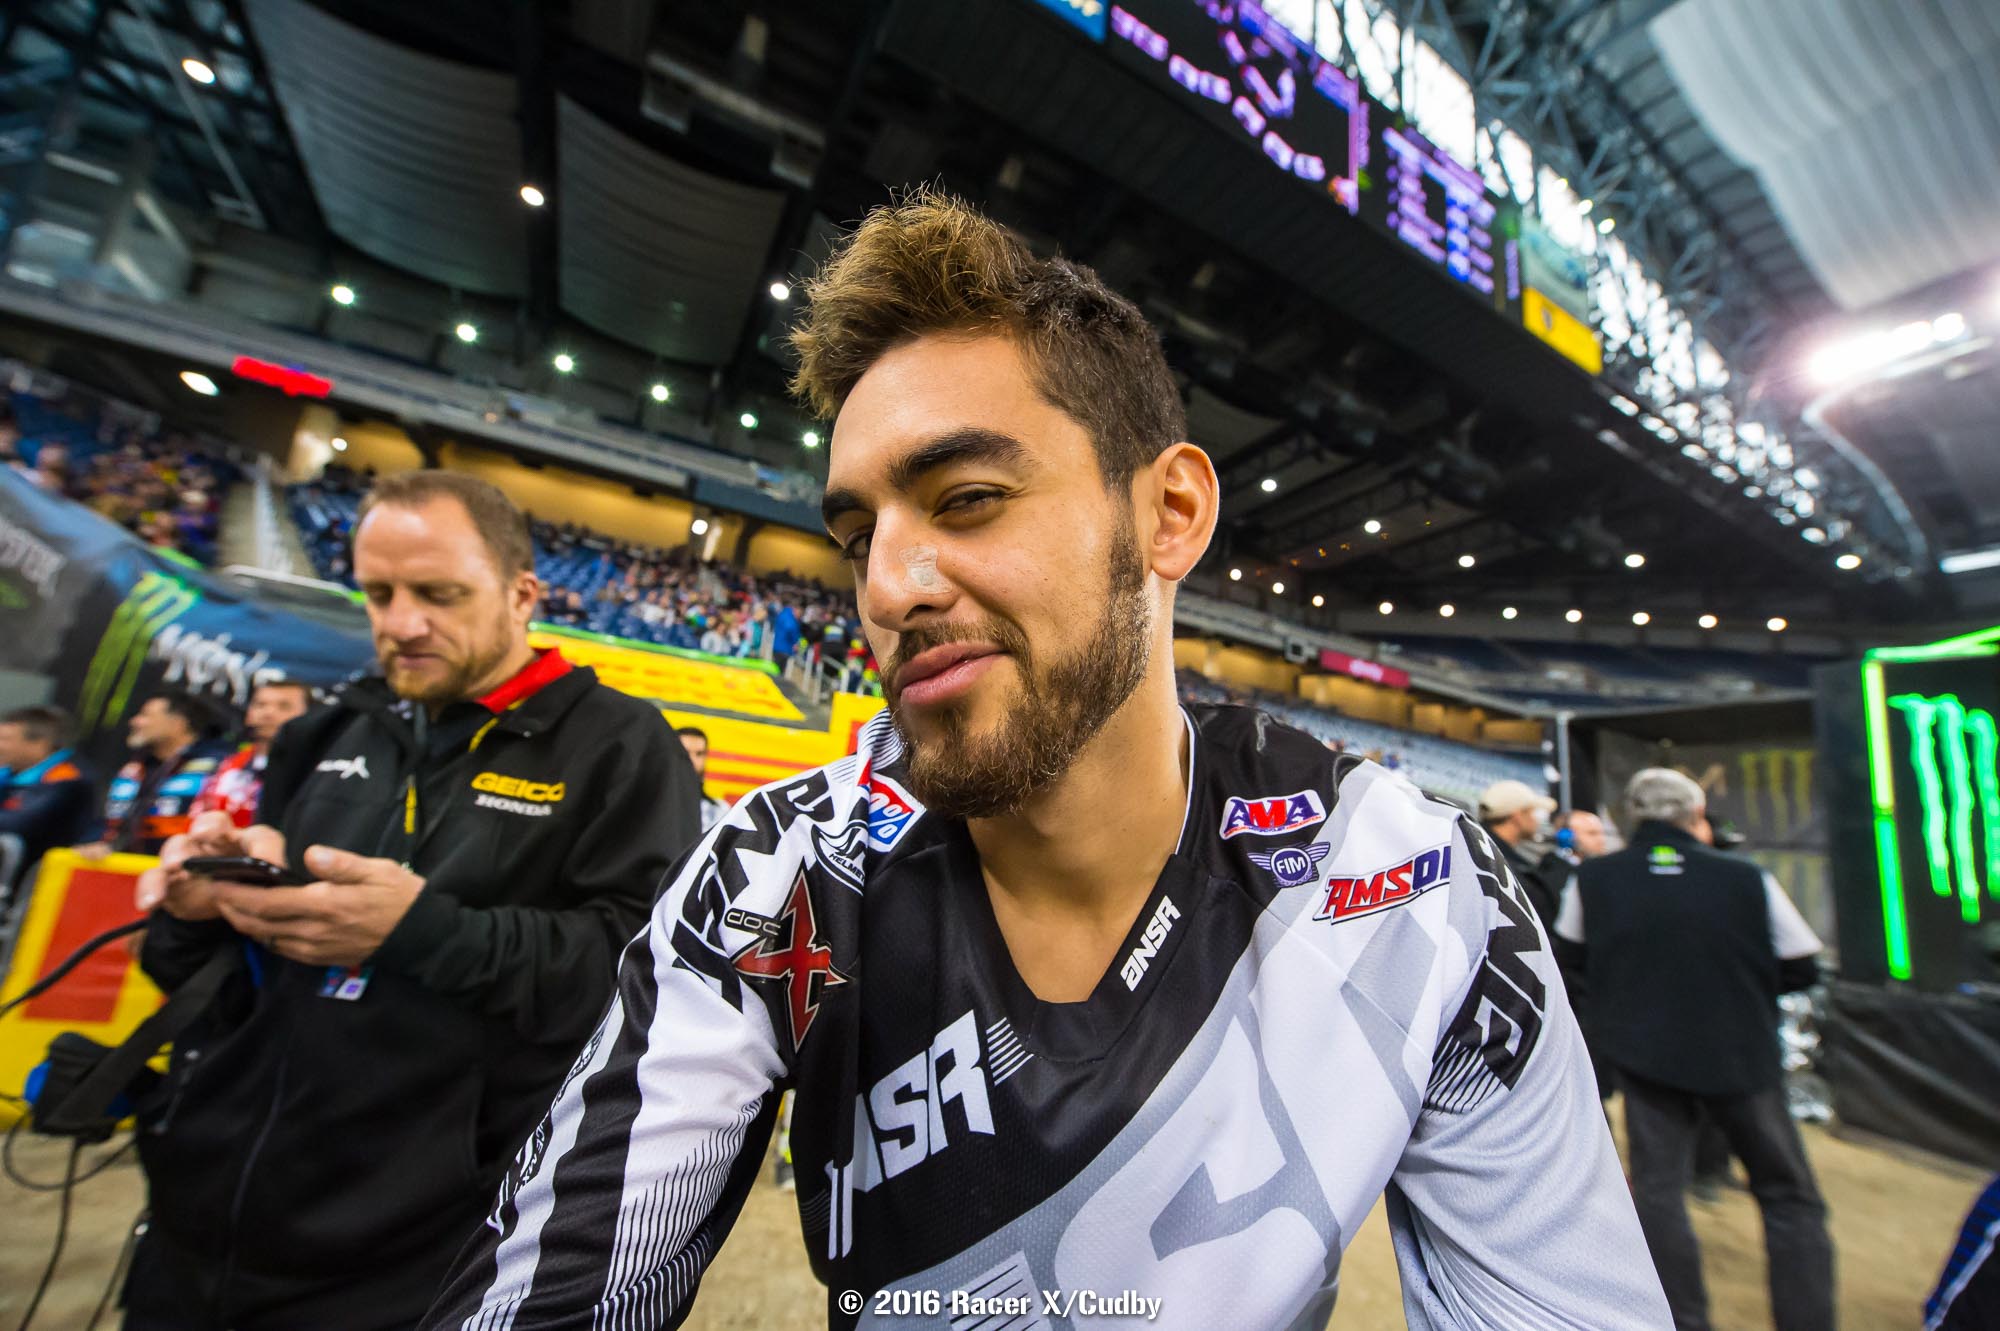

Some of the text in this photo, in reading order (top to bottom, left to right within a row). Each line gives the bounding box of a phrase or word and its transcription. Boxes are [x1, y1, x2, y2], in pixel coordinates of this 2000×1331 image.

[471, 771, 565, 801] GEICO
[474, 793, 552, 816] HONDA
[1224, 793, 1321, 834] AMA
[1276, 856, 1306, 875] FIM
[1323, 845, 1451, 919] AMSOI
[727, 911, 781, 936] doc
[1120, 895, 1181, 992] ANSR
